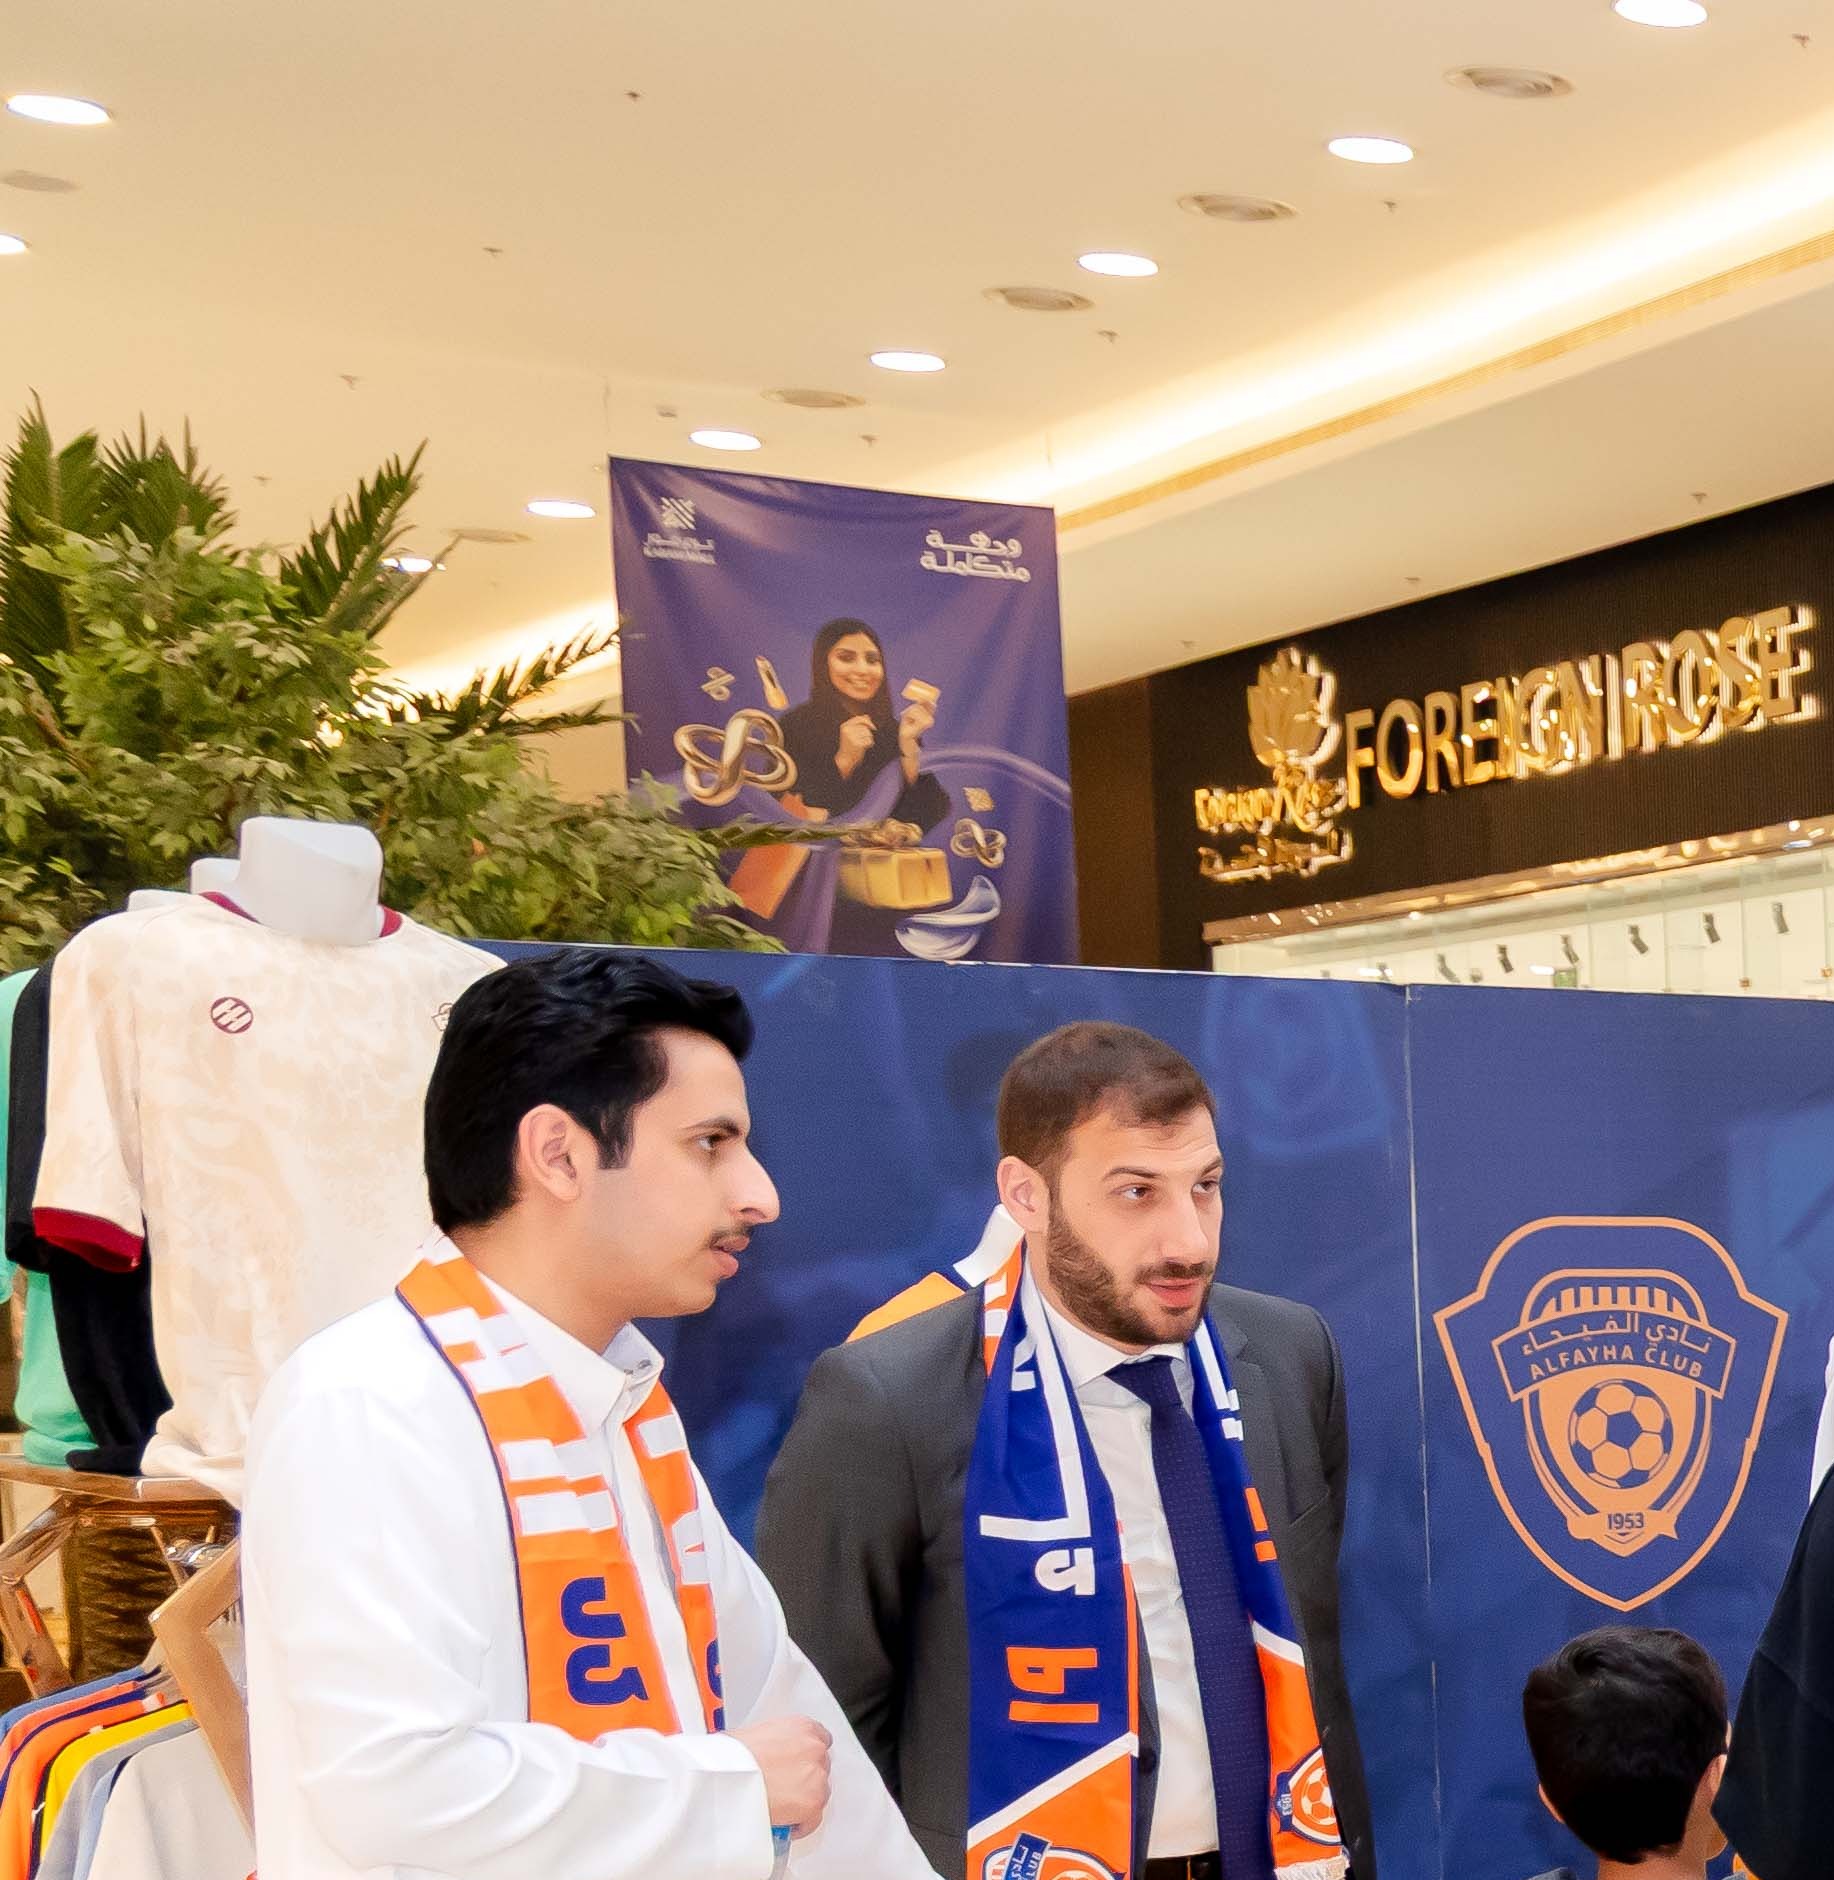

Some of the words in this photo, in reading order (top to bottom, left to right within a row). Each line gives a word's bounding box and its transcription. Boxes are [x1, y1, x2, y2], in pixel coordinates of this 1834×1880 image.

[1345, 653, 1608, 808] FOREIGN
[1622, 606, 1805, 752] ROSE
[1522, 1312, 1639, 1357] الفيحاء
[1645, 1319, 1712, 1354] نادي
[1529, 1344, 1635, 1381] ALFAYHA
[1644, 1345, 1704, 1379] CLUB
[1606, 1512, 1645, 1531] 1953
